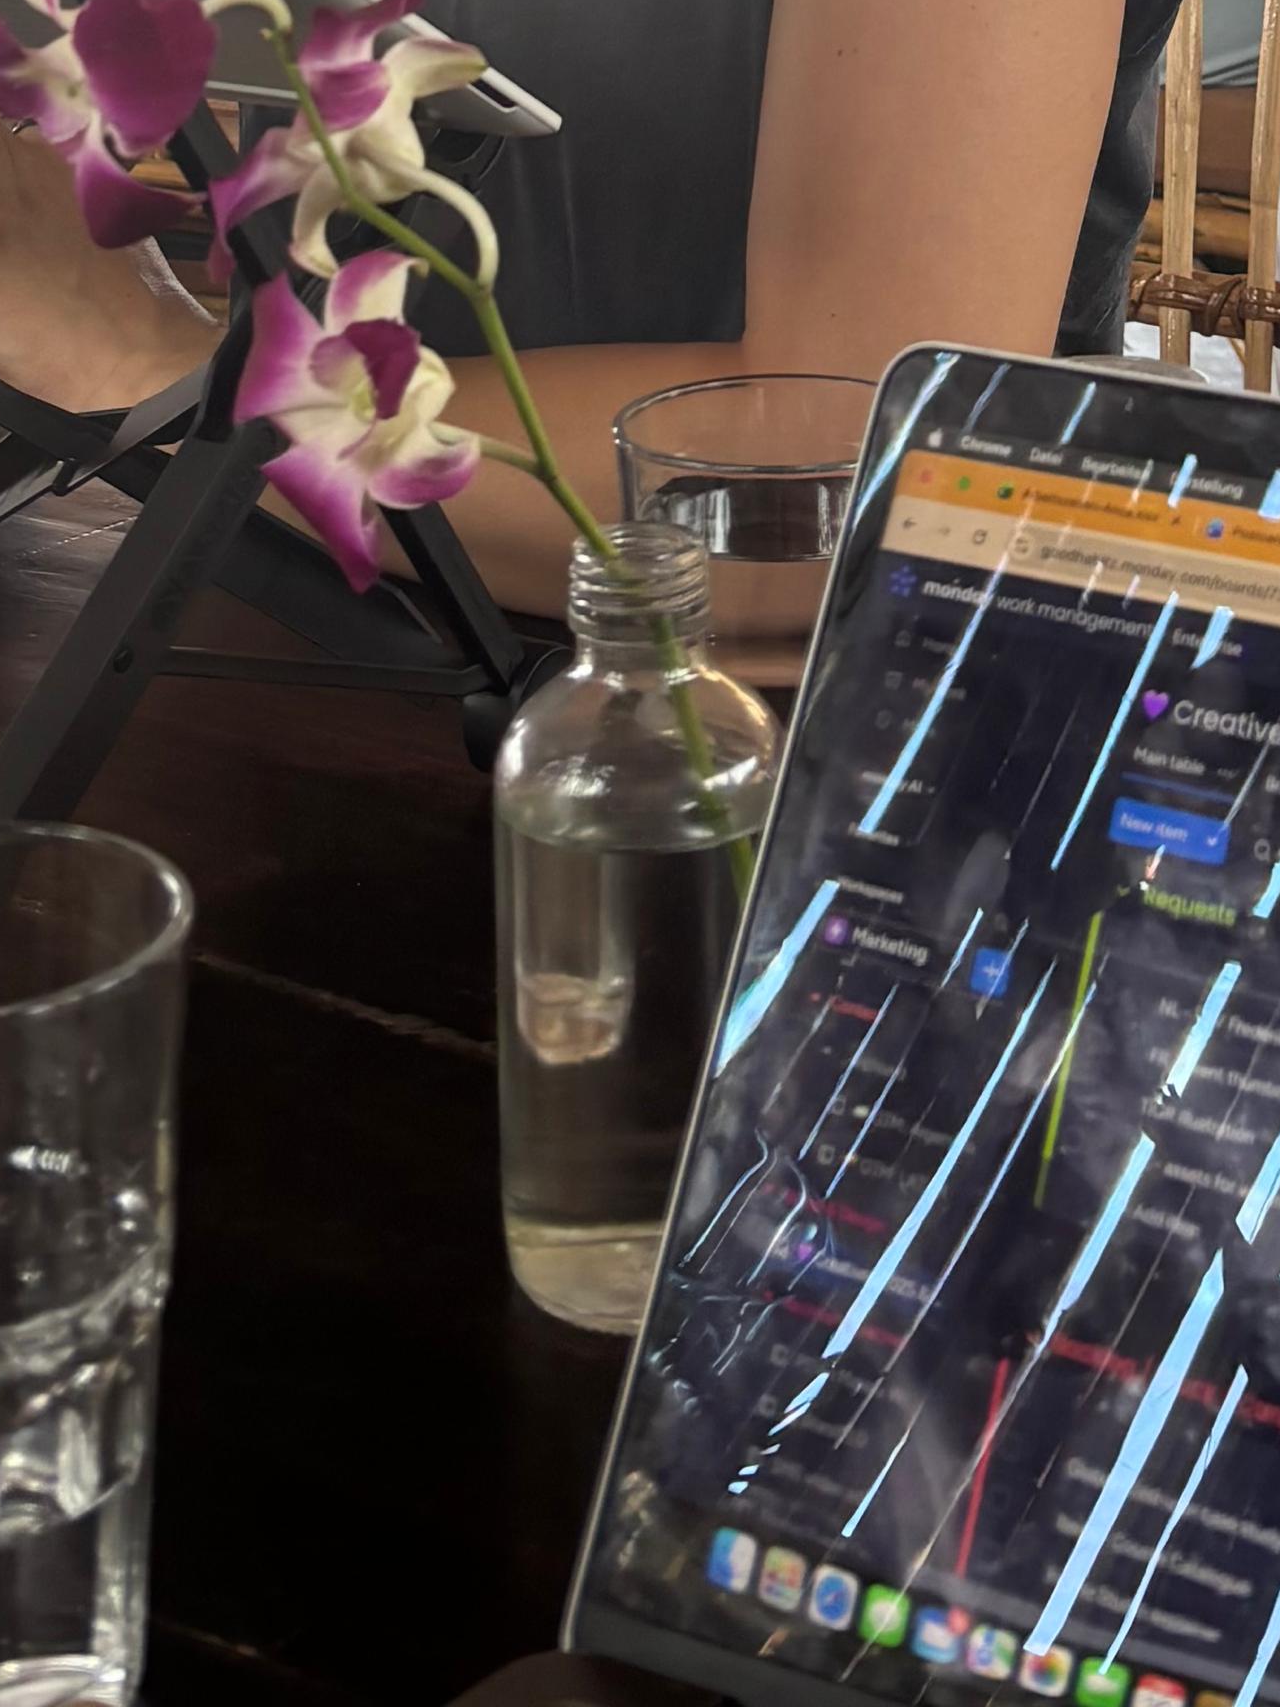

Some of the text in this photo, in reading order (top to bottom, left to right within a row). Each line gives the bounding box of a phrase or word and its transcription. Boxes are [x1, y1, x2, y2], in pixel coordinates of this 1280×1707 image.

[960, 435, 1013, 458] Chrome
[1029, 447, 1064, 466] Datei
[997, 592, 1036, 616] work
[1133, 745, 1206, 777] Main table
[1154, 821, 1190, 843] item
[1142, 886, 1238, 927] Requests
[851, 927, 929, 965] Marketing
